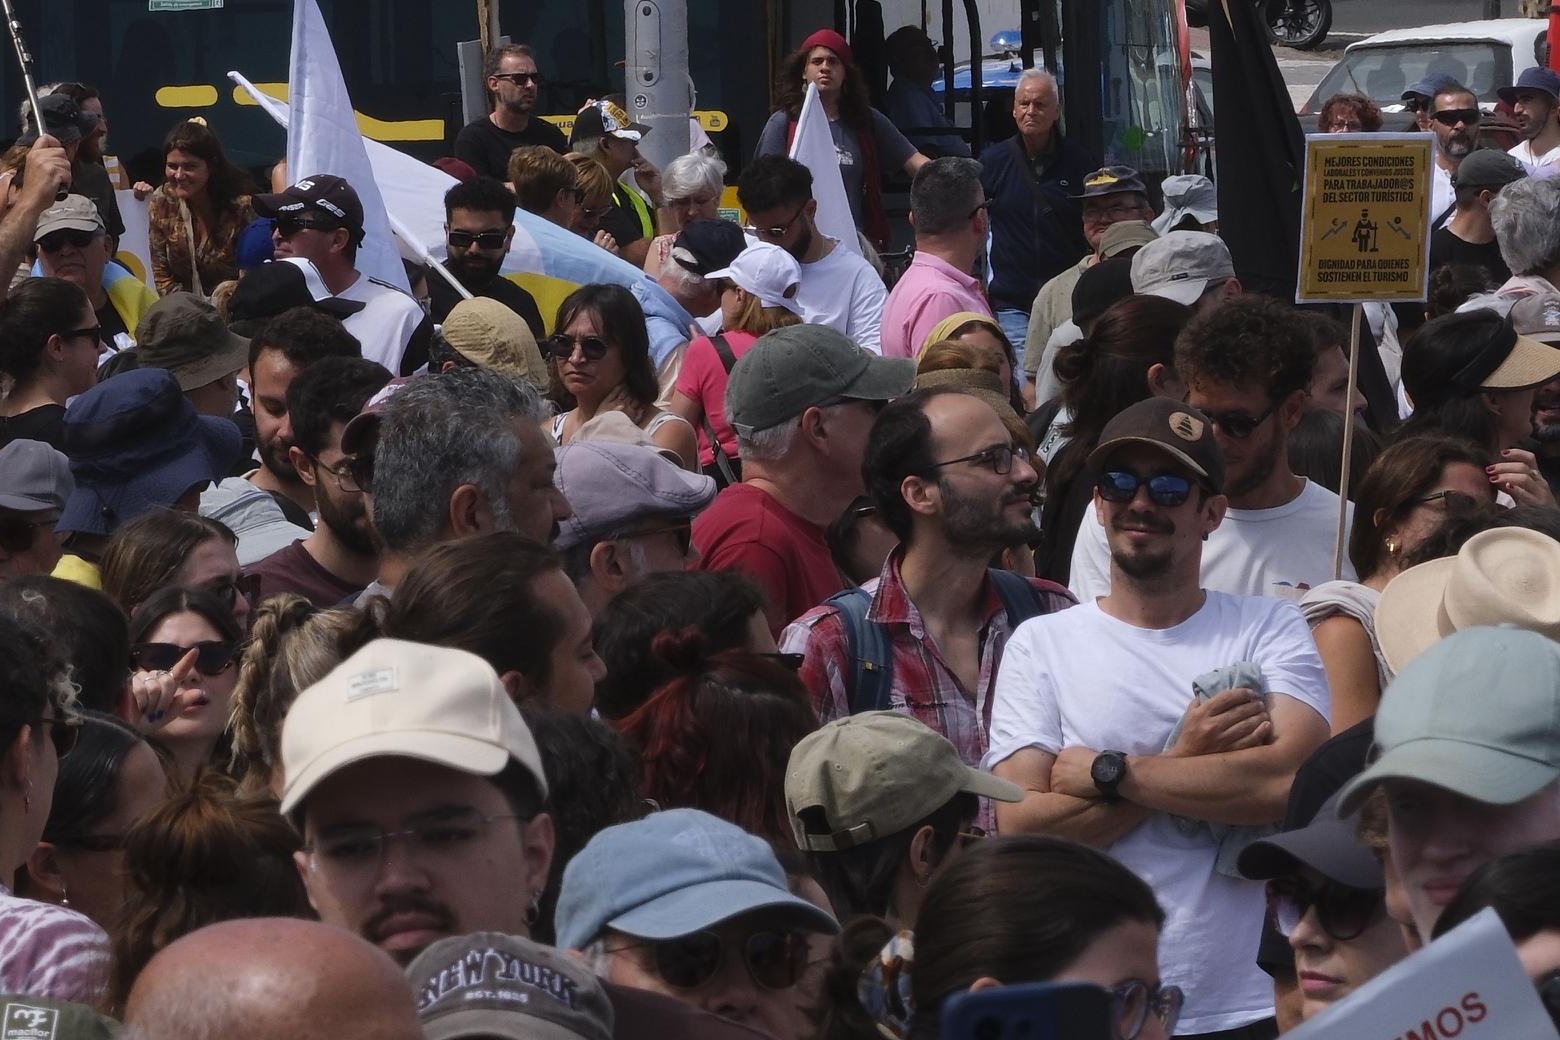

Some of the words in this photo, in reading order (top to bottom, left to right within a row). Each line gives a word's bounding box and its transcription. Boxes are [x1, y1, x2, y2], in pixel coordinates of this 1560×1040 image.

[1324, 156, 1361, 168] MEJORES
[1362, 156, 1415, 167] CONDICIONES
[1323, 168, 1357, 177] LABORALES
[1324, 179, 1345, 190] PARA
[1346, 178, 1414, 190] TRABAJADOR@S
[1323, 192, 1338, 203] DEL
[1339, 191, 1370, 203] SECTOR
[1371, 189, 1414, 203] TURÍSTICO
[1318, 259, 1355, 270] DIGNIDAD
[1356, 259, 1377, 270] PARA
[1378, 258, 1410, 269] QUIENES
[1317, 271, 1363, 283] SOSTIENEN
[1363, 271, 1372, 282] EL
[1373, 271, 1409, 282] TURISMO
[416, 948, 486, 1013] NEW
[497, 950, 578, 1008] YORK
